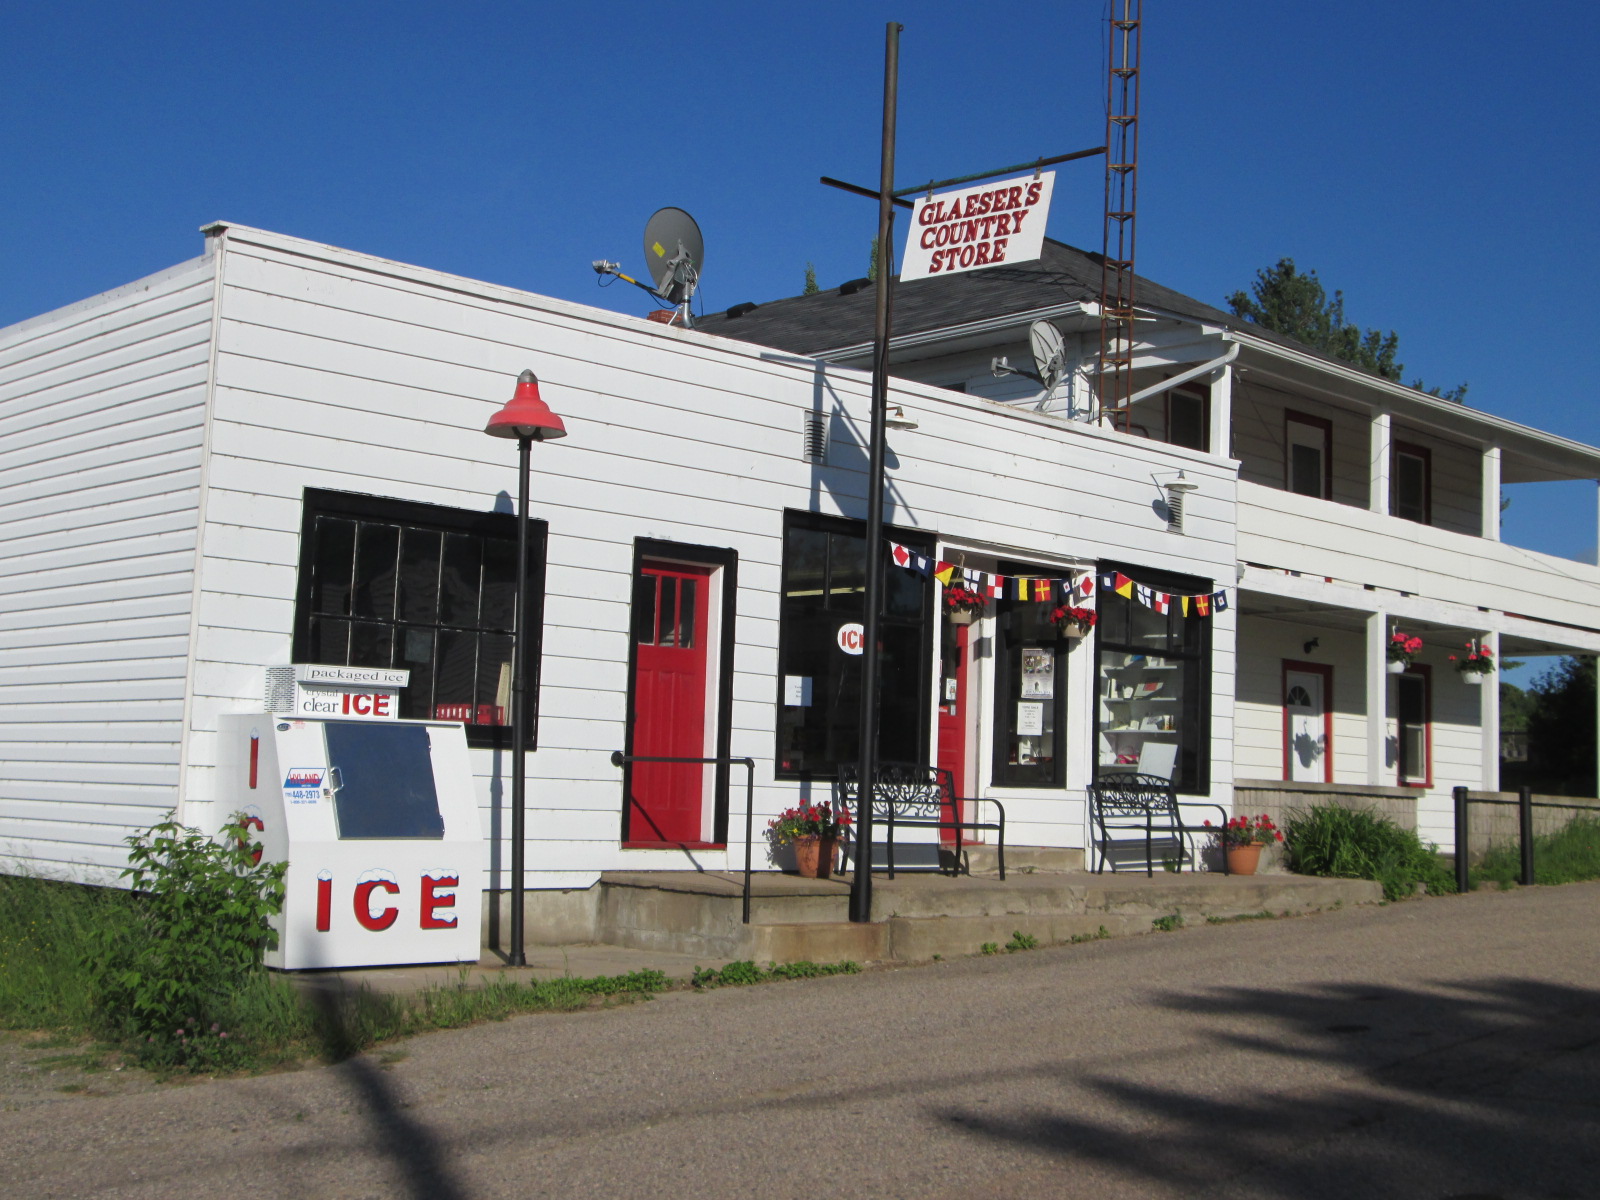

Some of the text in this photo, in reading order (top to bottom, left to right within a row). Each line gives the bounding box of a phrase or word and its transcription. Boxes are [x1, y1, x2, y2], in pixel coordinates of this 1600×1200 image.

[918, 181, 1043, 226] GLAESER'S
[920, 209, 1029, 250] COUNTRY
[929, 238, 1008, 273] STORE
[311, 669, 404, 682] packaged ice
[303, 692, 391, 716] clear ICE
[306, 689, 338, 698] crystal
[316, 868, 459, 932] ICE
